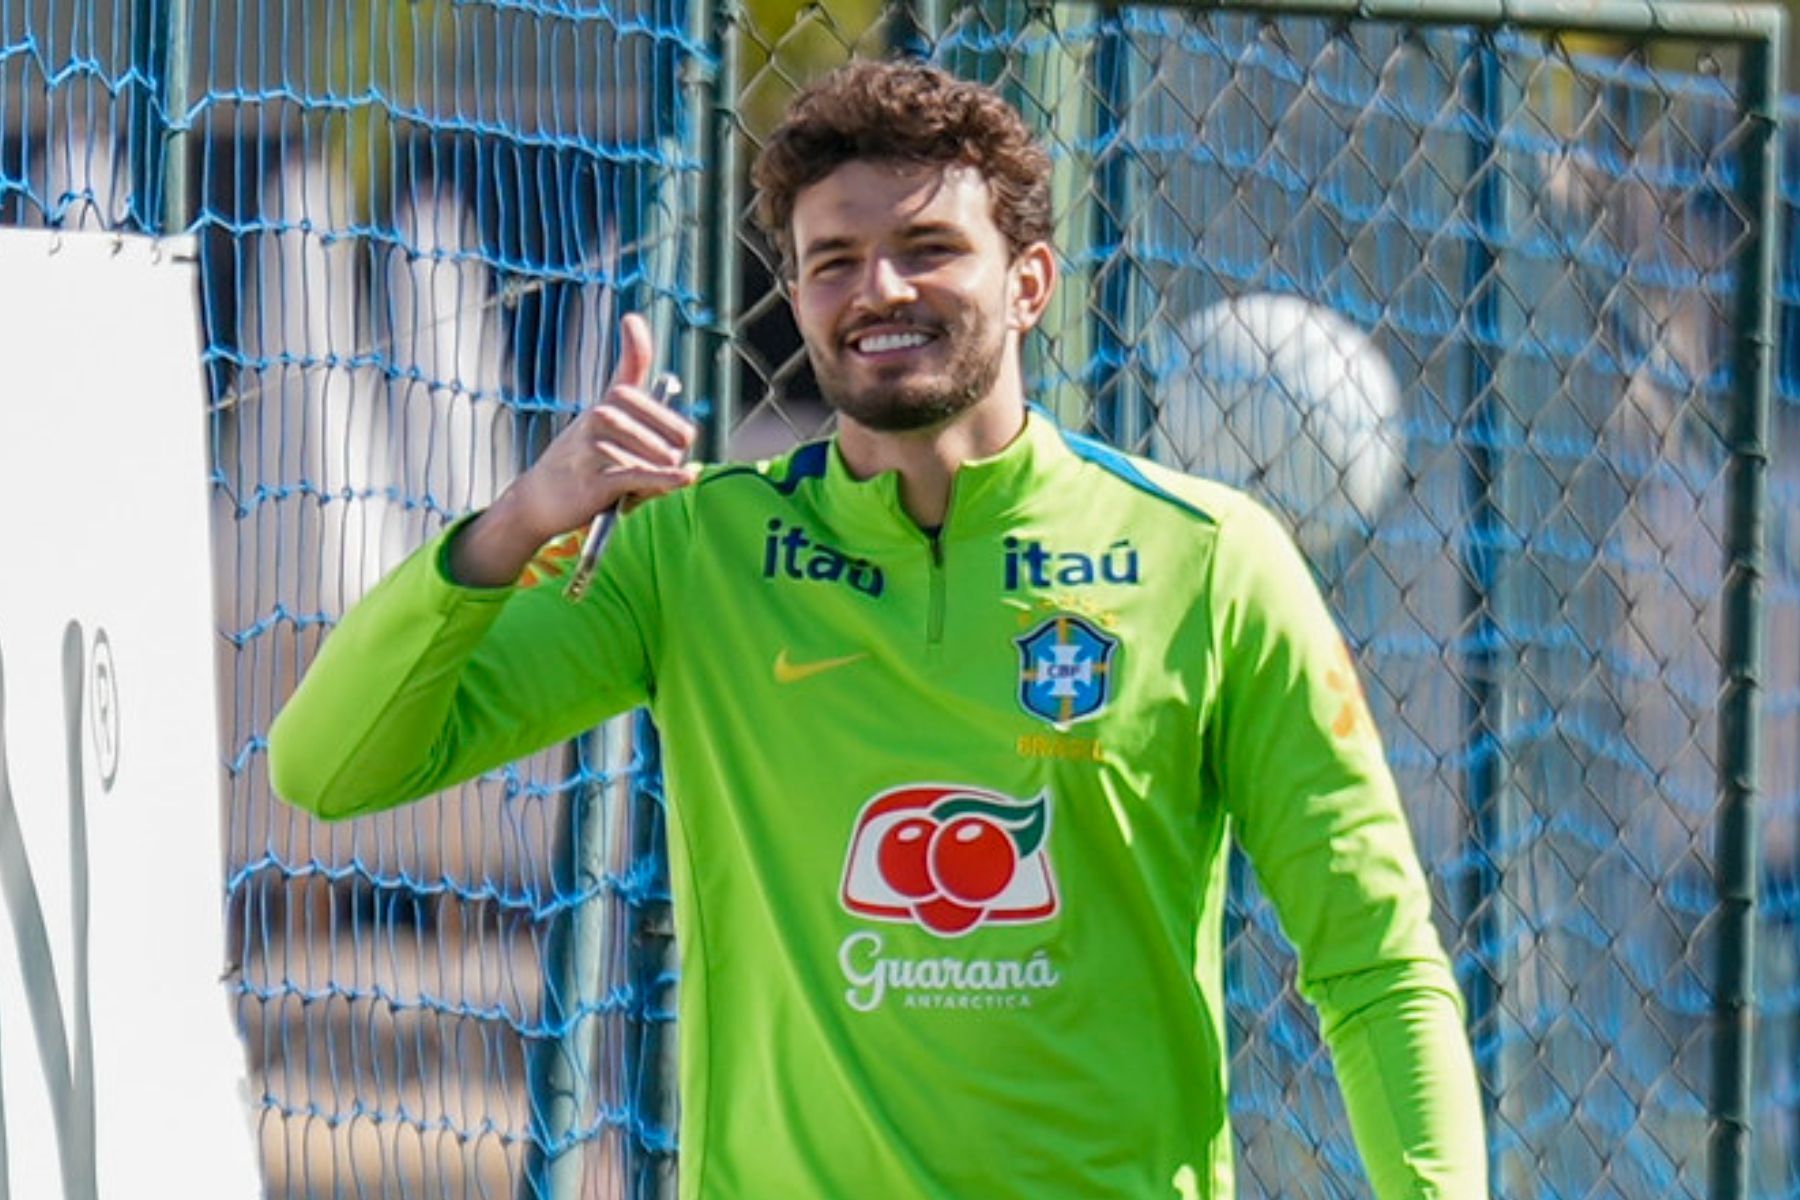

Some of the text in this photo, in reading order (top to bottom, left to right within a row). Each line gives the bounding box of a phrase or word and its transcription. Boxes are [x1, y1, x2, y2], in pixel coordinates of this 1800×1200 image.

[1003, 535, 1140, 591] itaú
[838, 931, 1060, 1012] Guaraná
[903, 993, 1032, 1008] ANTARCTICA
